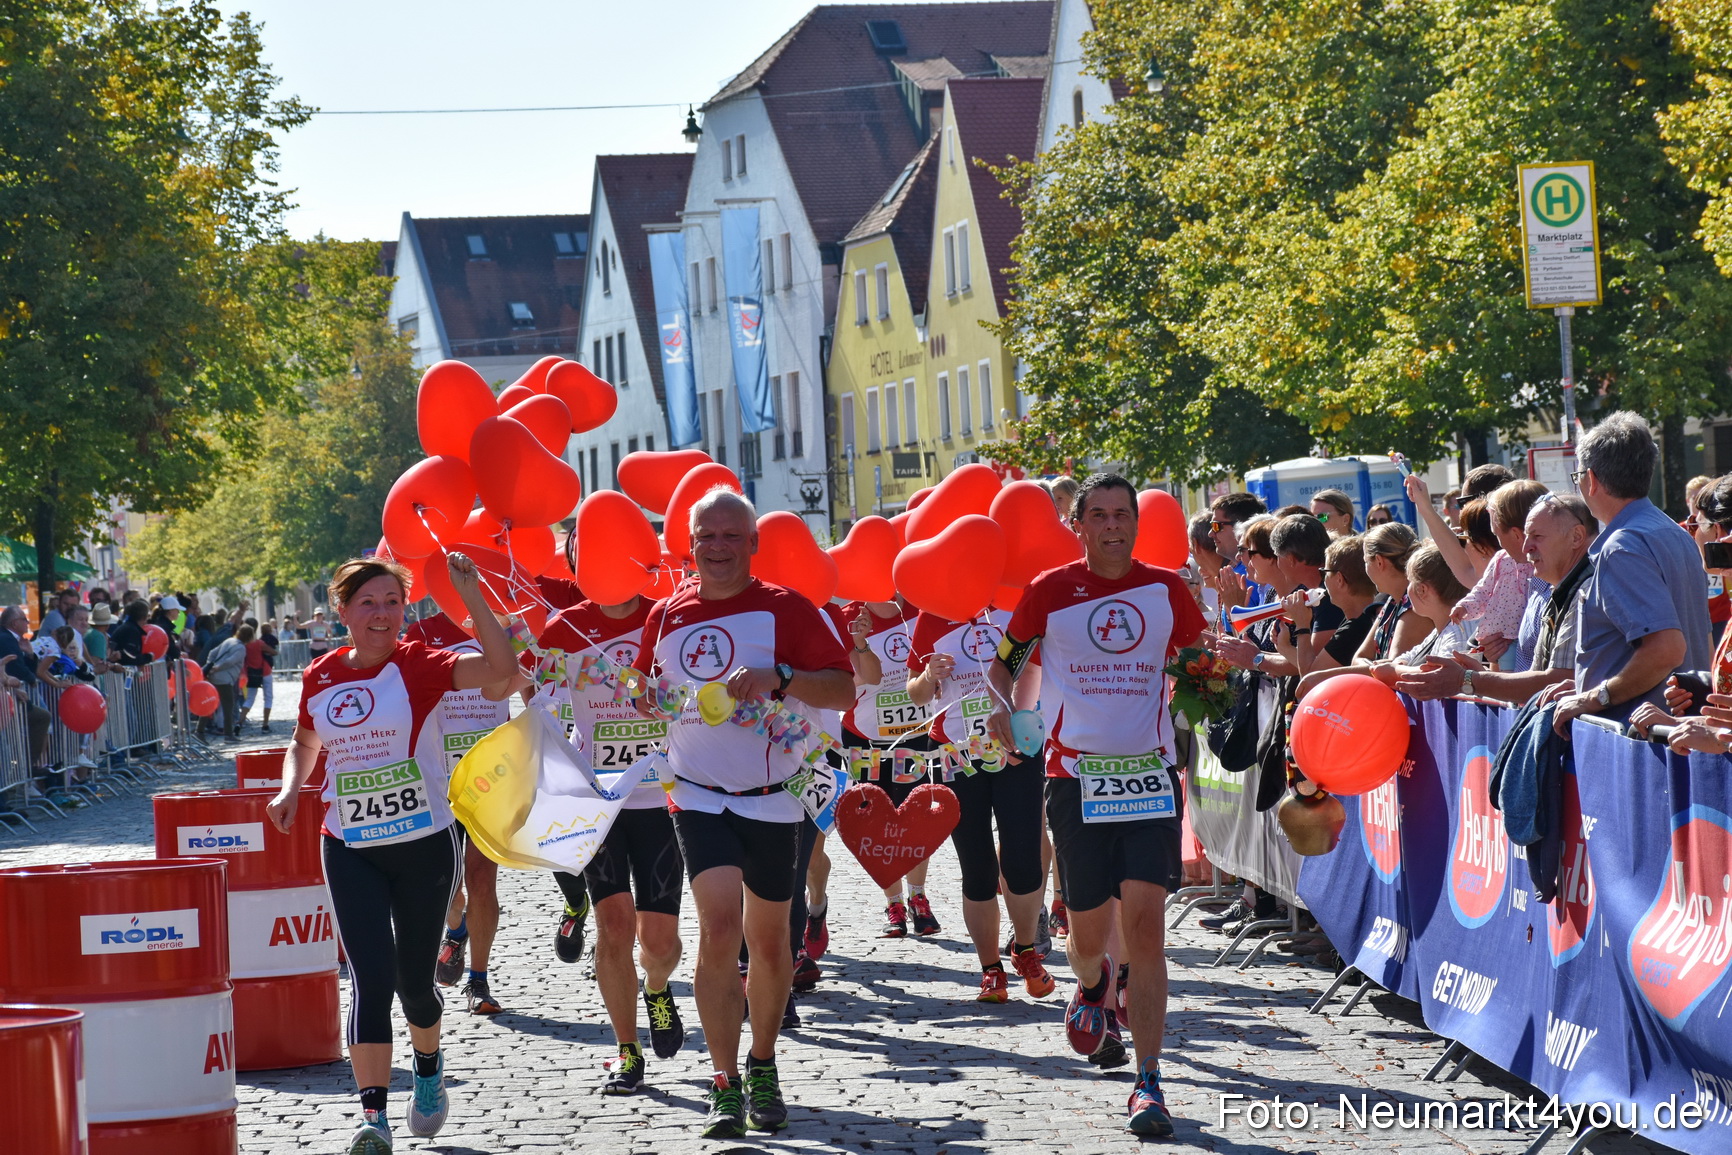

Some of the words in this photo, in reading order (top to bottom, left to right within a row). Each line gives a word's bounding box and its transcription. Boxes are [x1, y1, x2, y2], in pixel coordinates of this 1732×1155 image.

[1544, 185, 1571, 216] H
[1538, 233, 1583, 242] Marktplatz
[662, 313, 684, 364] K&L
[870, 351, 894, 378] HOTEL
[950, 671, 983, 682] LAUFEN
[1070, 664, 1109, 673] LAUFEN
[1113, 664, 1132, 672] MIT
[883, 705, 926, 725] 5121
[349, 733, 367, 743] MIT
[370, 729, 397, 739] HERZ
[599, 719, 663, 739] BOCK
[366, 741, 389, 750] Röschl
[1085, 754, 1158, 774] BOCK
[342, 763, 415, 793] BOCK
[1091, 774, 1163, 797] 2308
[346, 788, 419, 823] 2458
[1091, 799, 1166, 814] JOHANNES
[360, 818, 415, 840] RENATE
[884, 822, 908, 838] für
[1458, 787, 1506, 889] Hervis
[219, 844, 249, 853] energie
[859, 837, 926, 865] Regina
[269, 905, 334, 947] AVIA
[147, 940, 184, 951] energie
[1432, 960, 1464, 1005] GET
[1640, 957, 1677, 988] SPORTS
